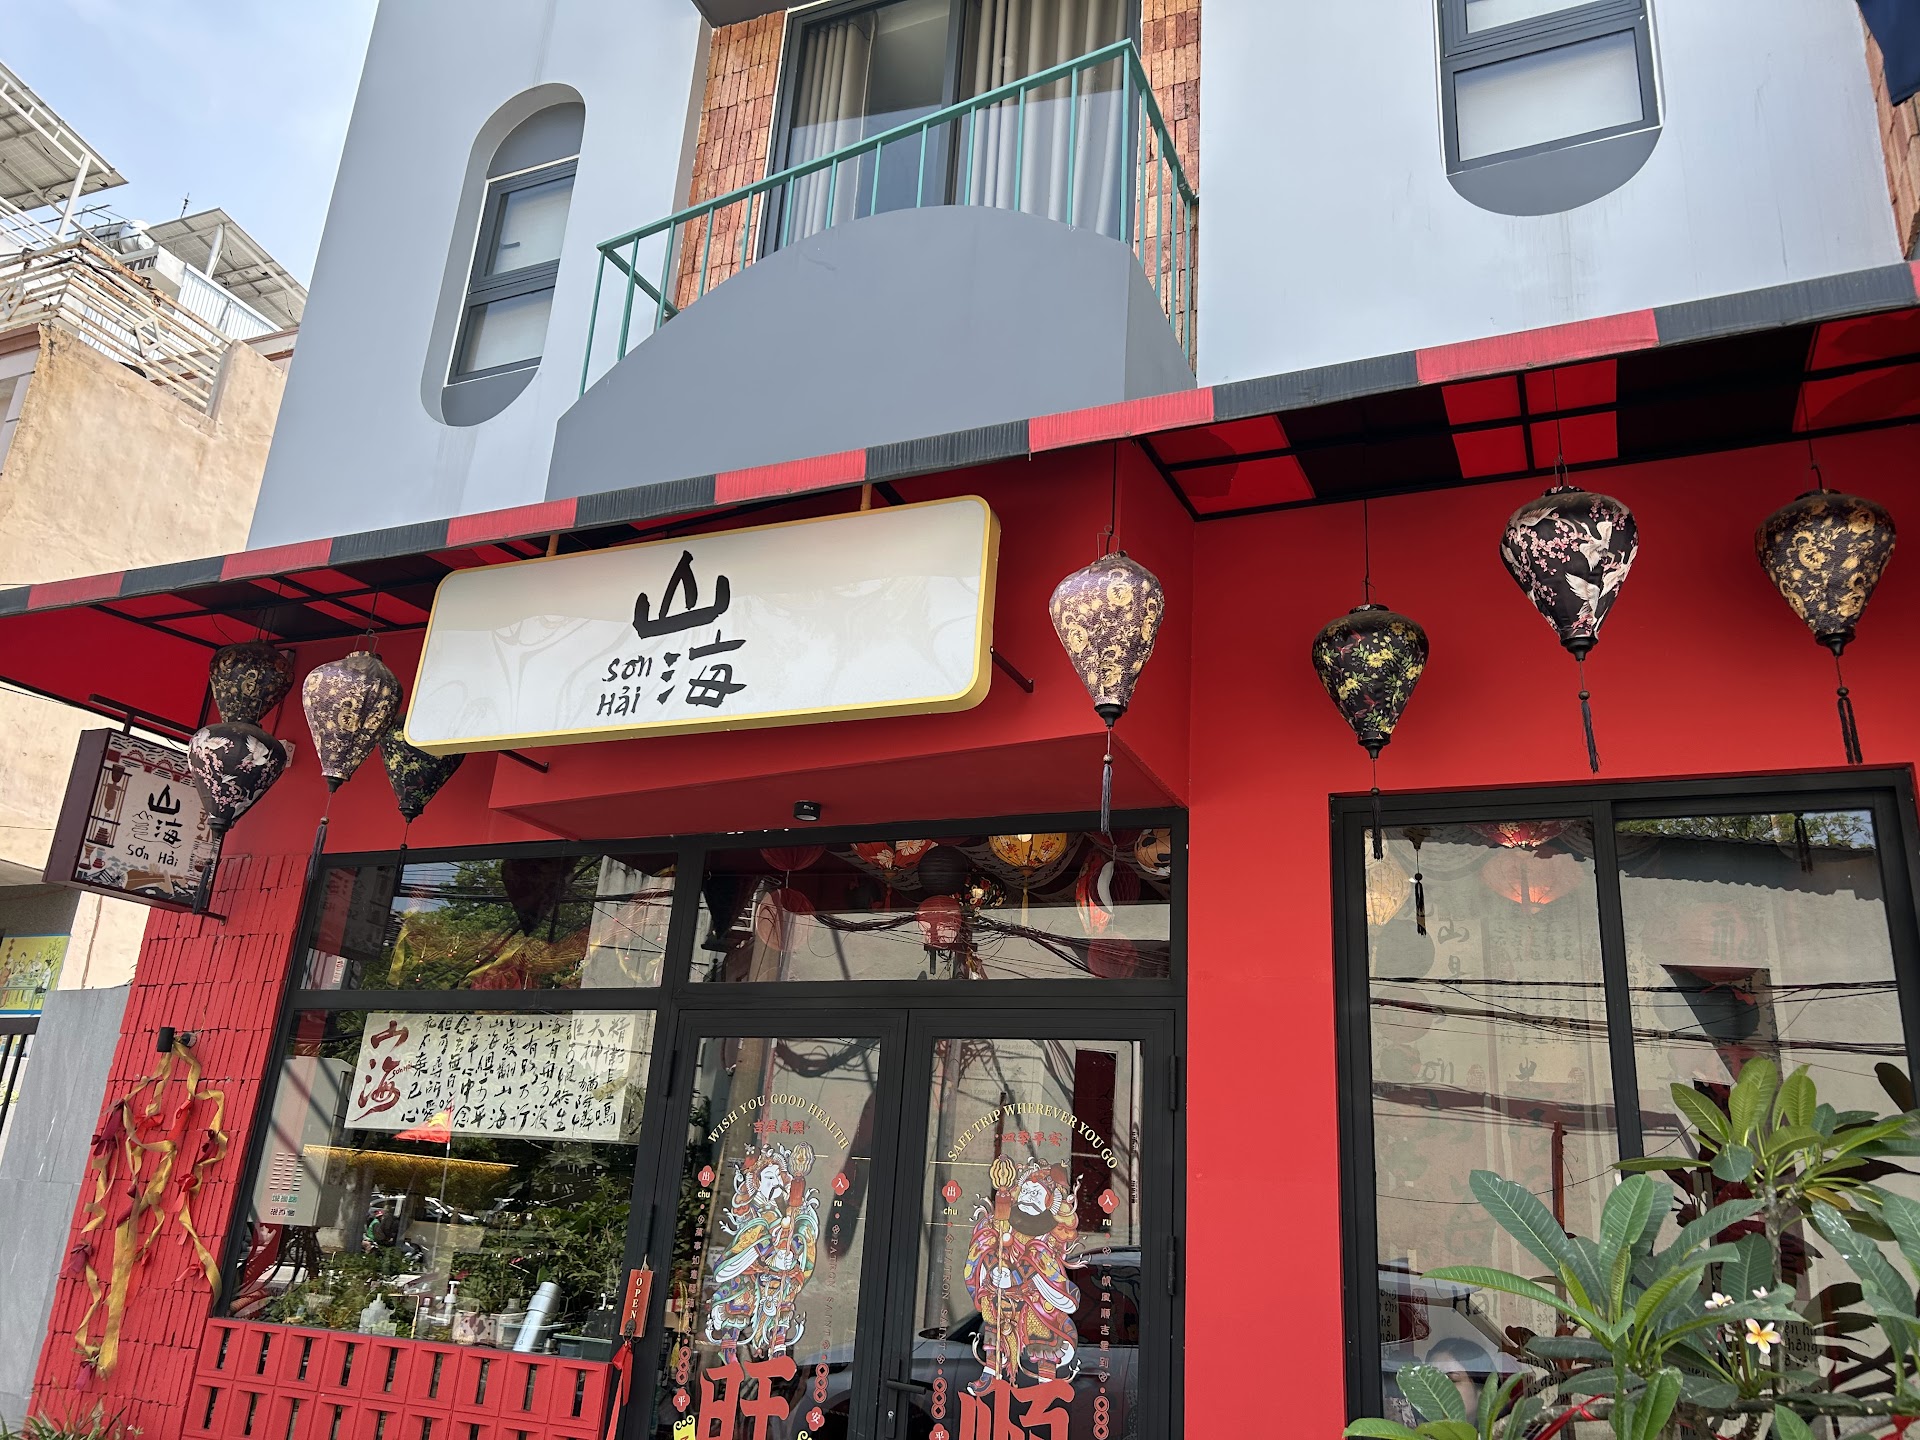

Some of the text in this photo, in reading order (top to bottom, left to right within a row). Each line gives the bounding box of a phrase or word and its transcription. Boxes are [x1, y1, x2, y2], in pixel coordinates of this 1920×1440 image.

[633, 549, 747, 708] 山海
[602, 654, 652, 684] Sơn
[596, 686, 642, 717] Hải
[148, 784, 183, 845] 山海
[126, 844, 149, 861] Sơn
[158, 850, 179, 867] Hải
[708, 1093, 850, 1150] WISH YOU GOOD HEALTH
[948, 1130, 974, 1162] SAFE
[973, 1109, 1001, 1139] TRIP
[1003, 1102, 1077, 1129] WHEREVER
[1078, 1121, 1105, 1149] YOU
[1101, 1147, 1120, 1169] GO
[697, 1189, 711, 1198] chu
[834, 1199, 843, 1208] ru
[943, 1206, 958, 1216] chu
[1102, 1217, 1112, 1227] ru
[826, 1238, 839, 1288] PATRON
[630, 1277, 643, 1319] OPEN
[938, 1248, 954, 1351] PATRON SAINT
